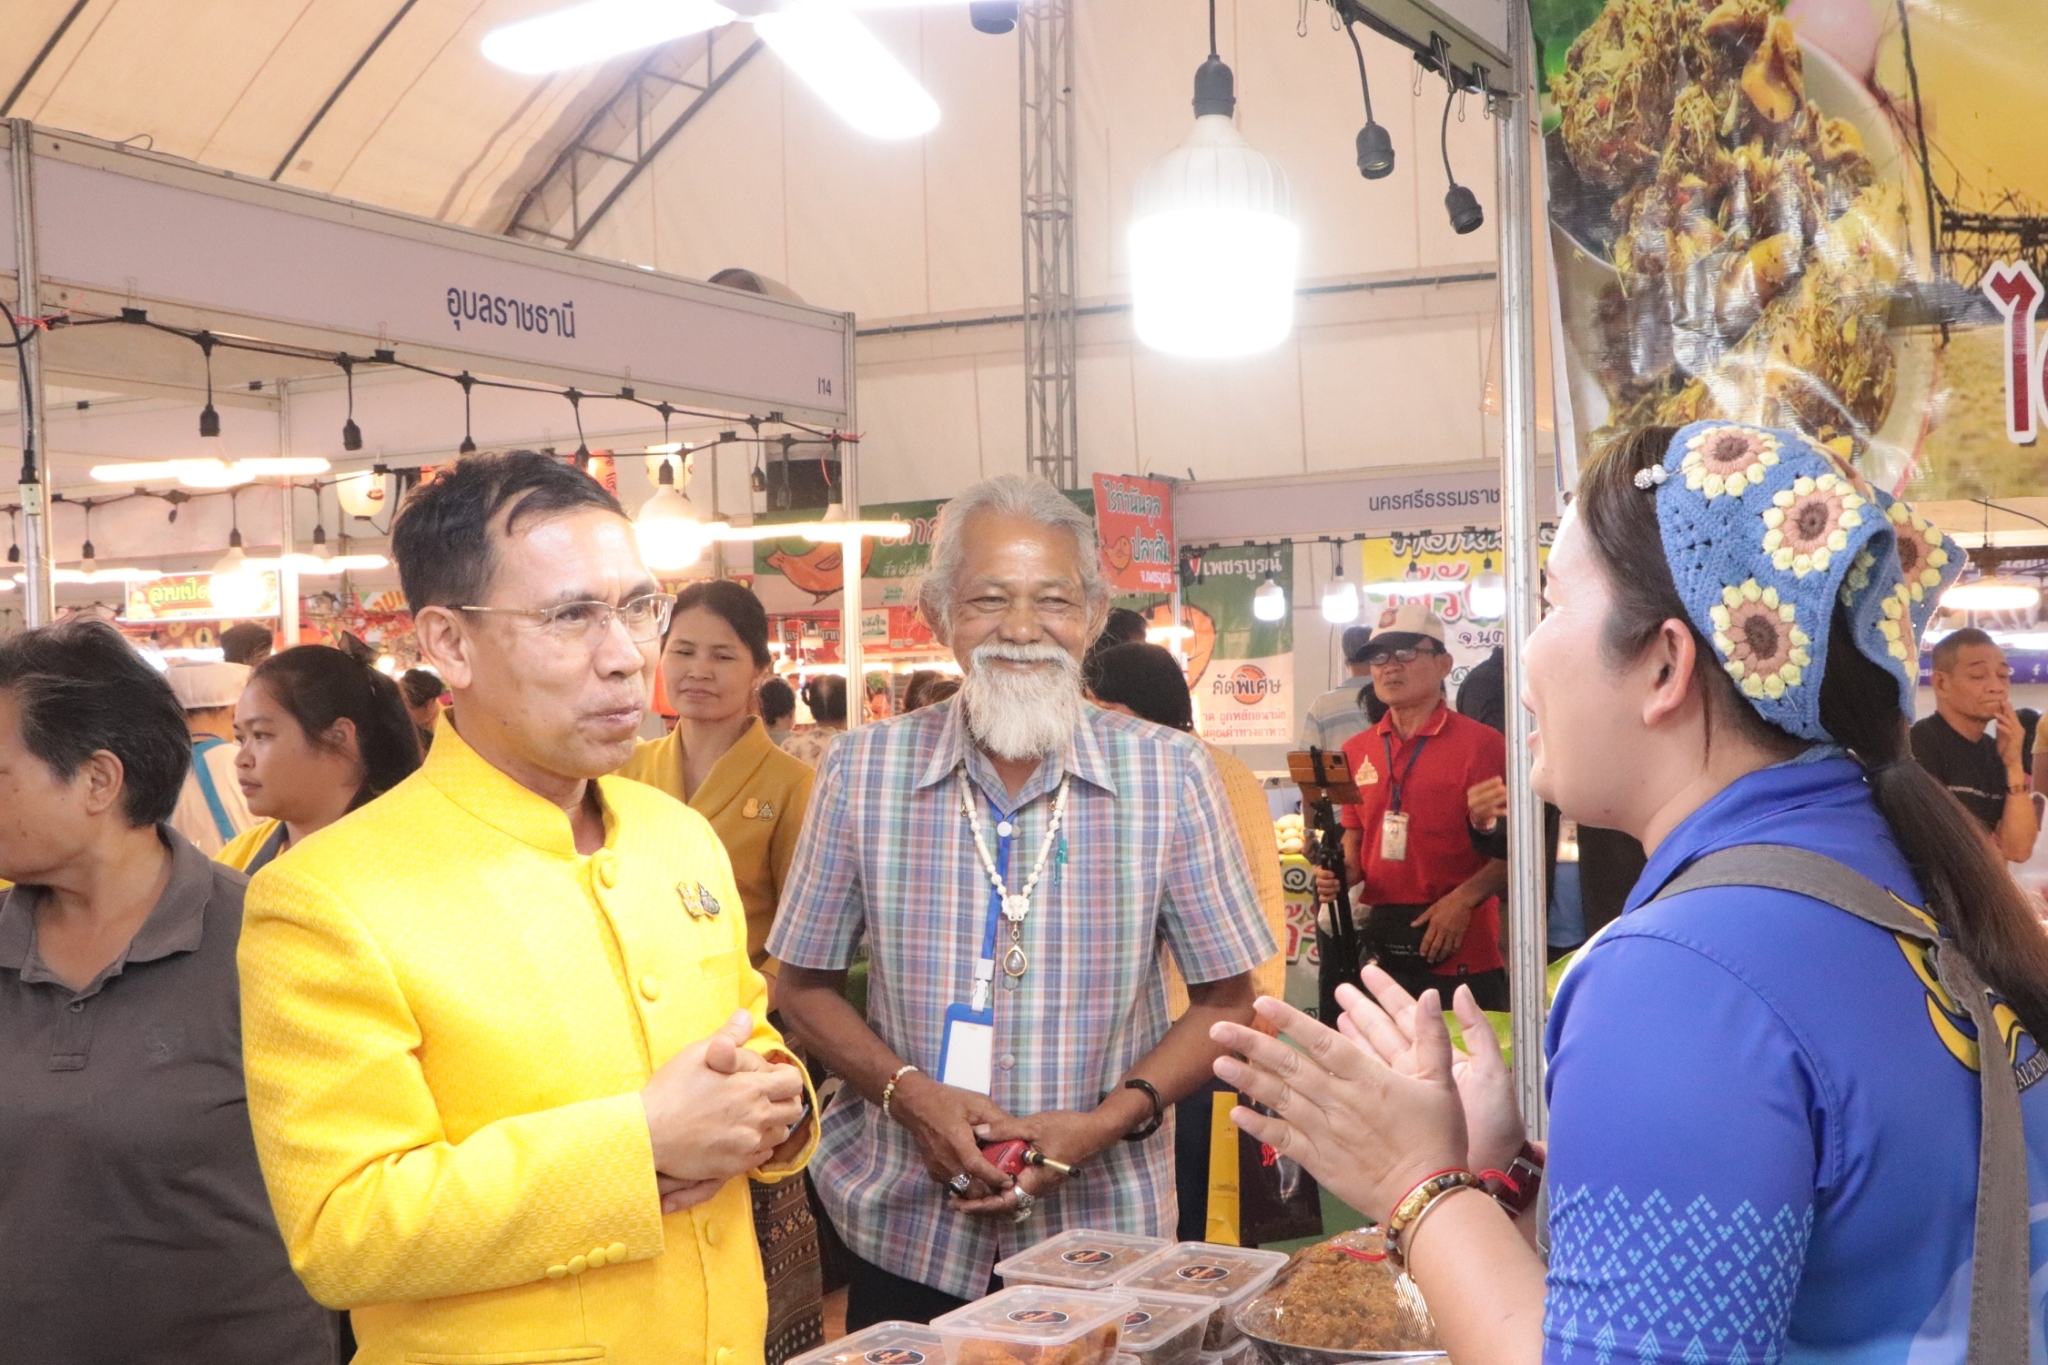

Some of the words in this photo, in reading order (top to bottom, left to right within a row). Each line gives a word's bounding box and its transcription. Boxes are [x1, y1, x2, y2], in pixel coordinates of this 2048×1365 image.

[447, 287, 576, 339] อุบลราชธานี
[818, 377, 832, 397] I14
[1369, 488, 1500, 511] นครศรีธรรมราช
[1131, 526, 1171, 564] ปลาส้ม
[1203, 551, 1283, 580] เพชรบูรณ์
[1212, 673, 1282, 695] คัดพิเศษ
